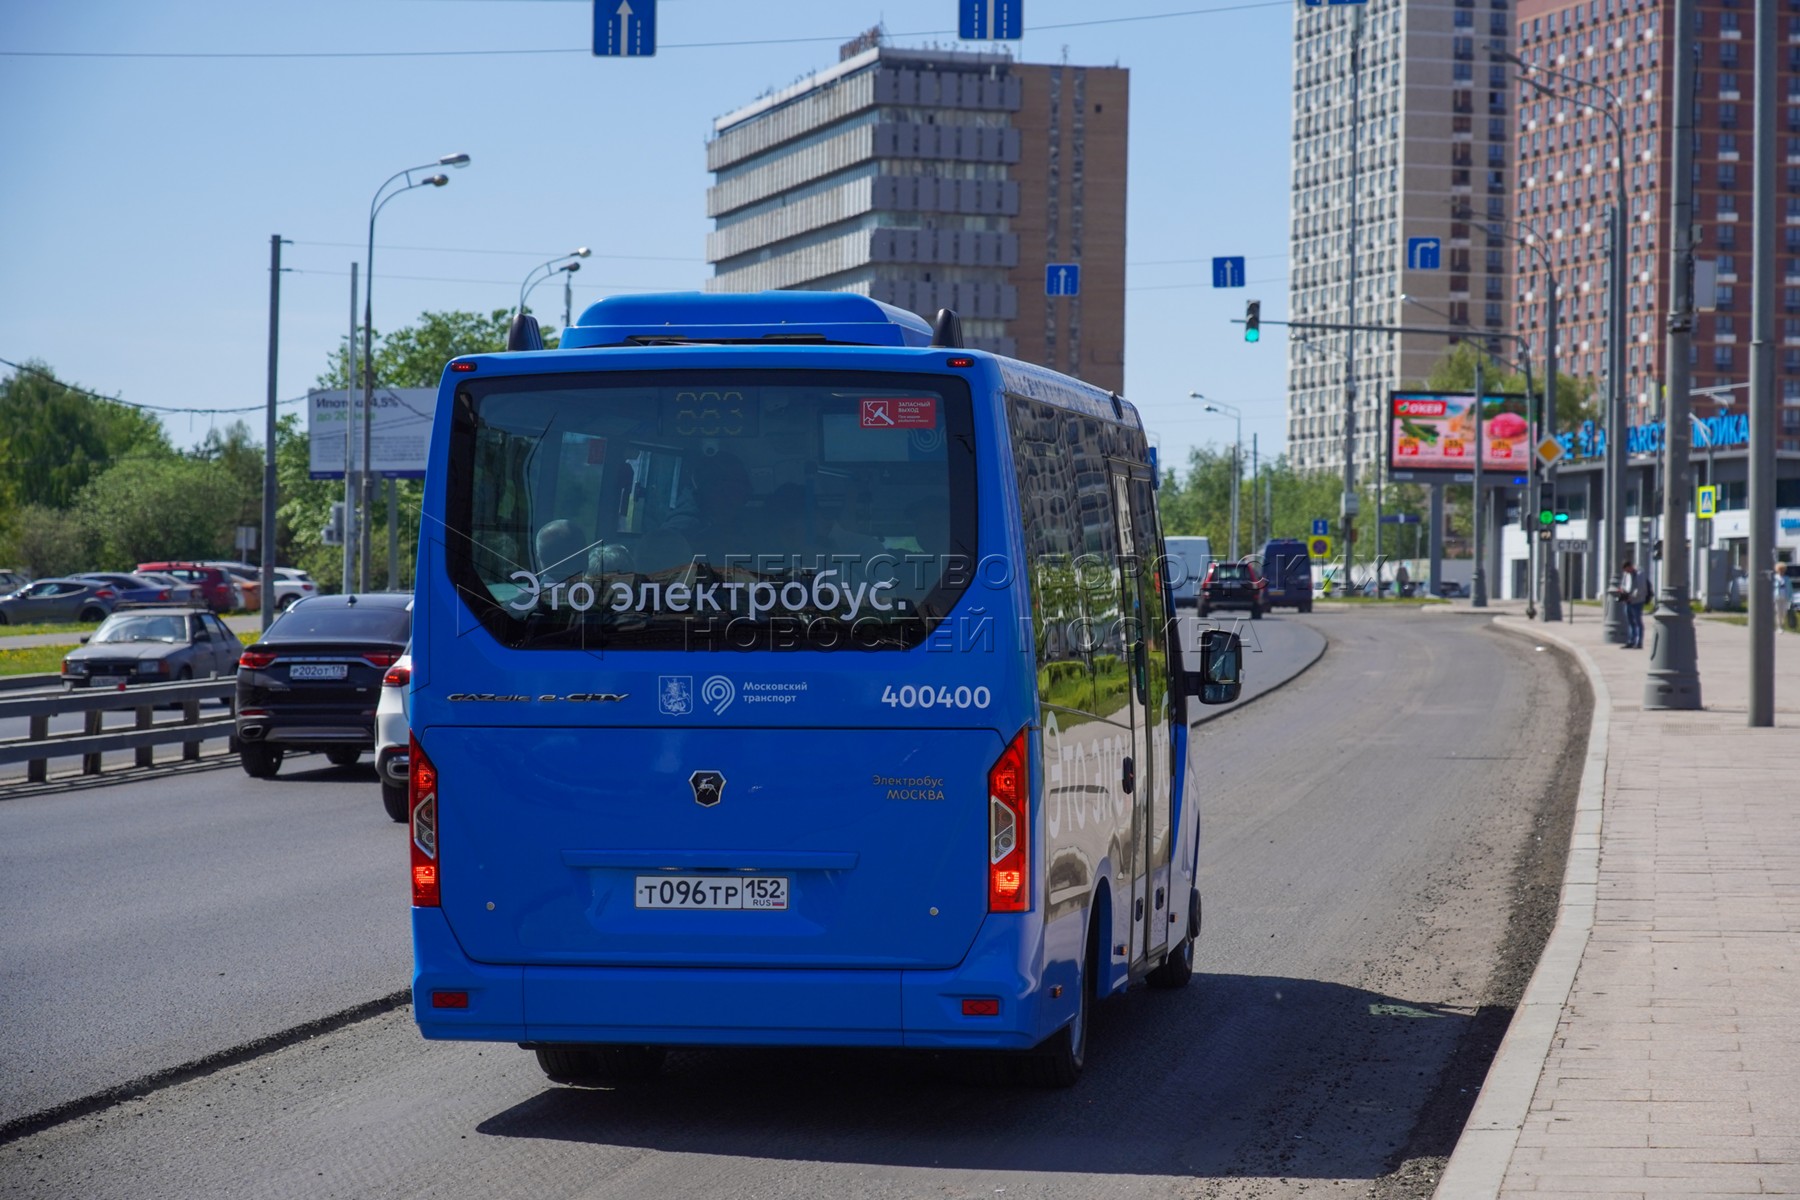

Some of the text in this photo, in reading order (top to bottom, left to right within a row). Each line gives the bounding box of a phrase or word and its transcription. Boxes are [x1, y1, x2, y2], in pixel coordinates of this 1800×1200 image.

[509, 569, 906, 621] Это электробус.
[743, 682, 808, 691] Московский
[743, 695, 797, 704] транспорт
[881, 685, 991, 708] 400400
[872, 774, 944, 788] Электробус
[886, 789, 945, 800] МОСКВА
[644, 880, 781, 905] Т096ТР 152
[752, 899, 771, 907] RUS
